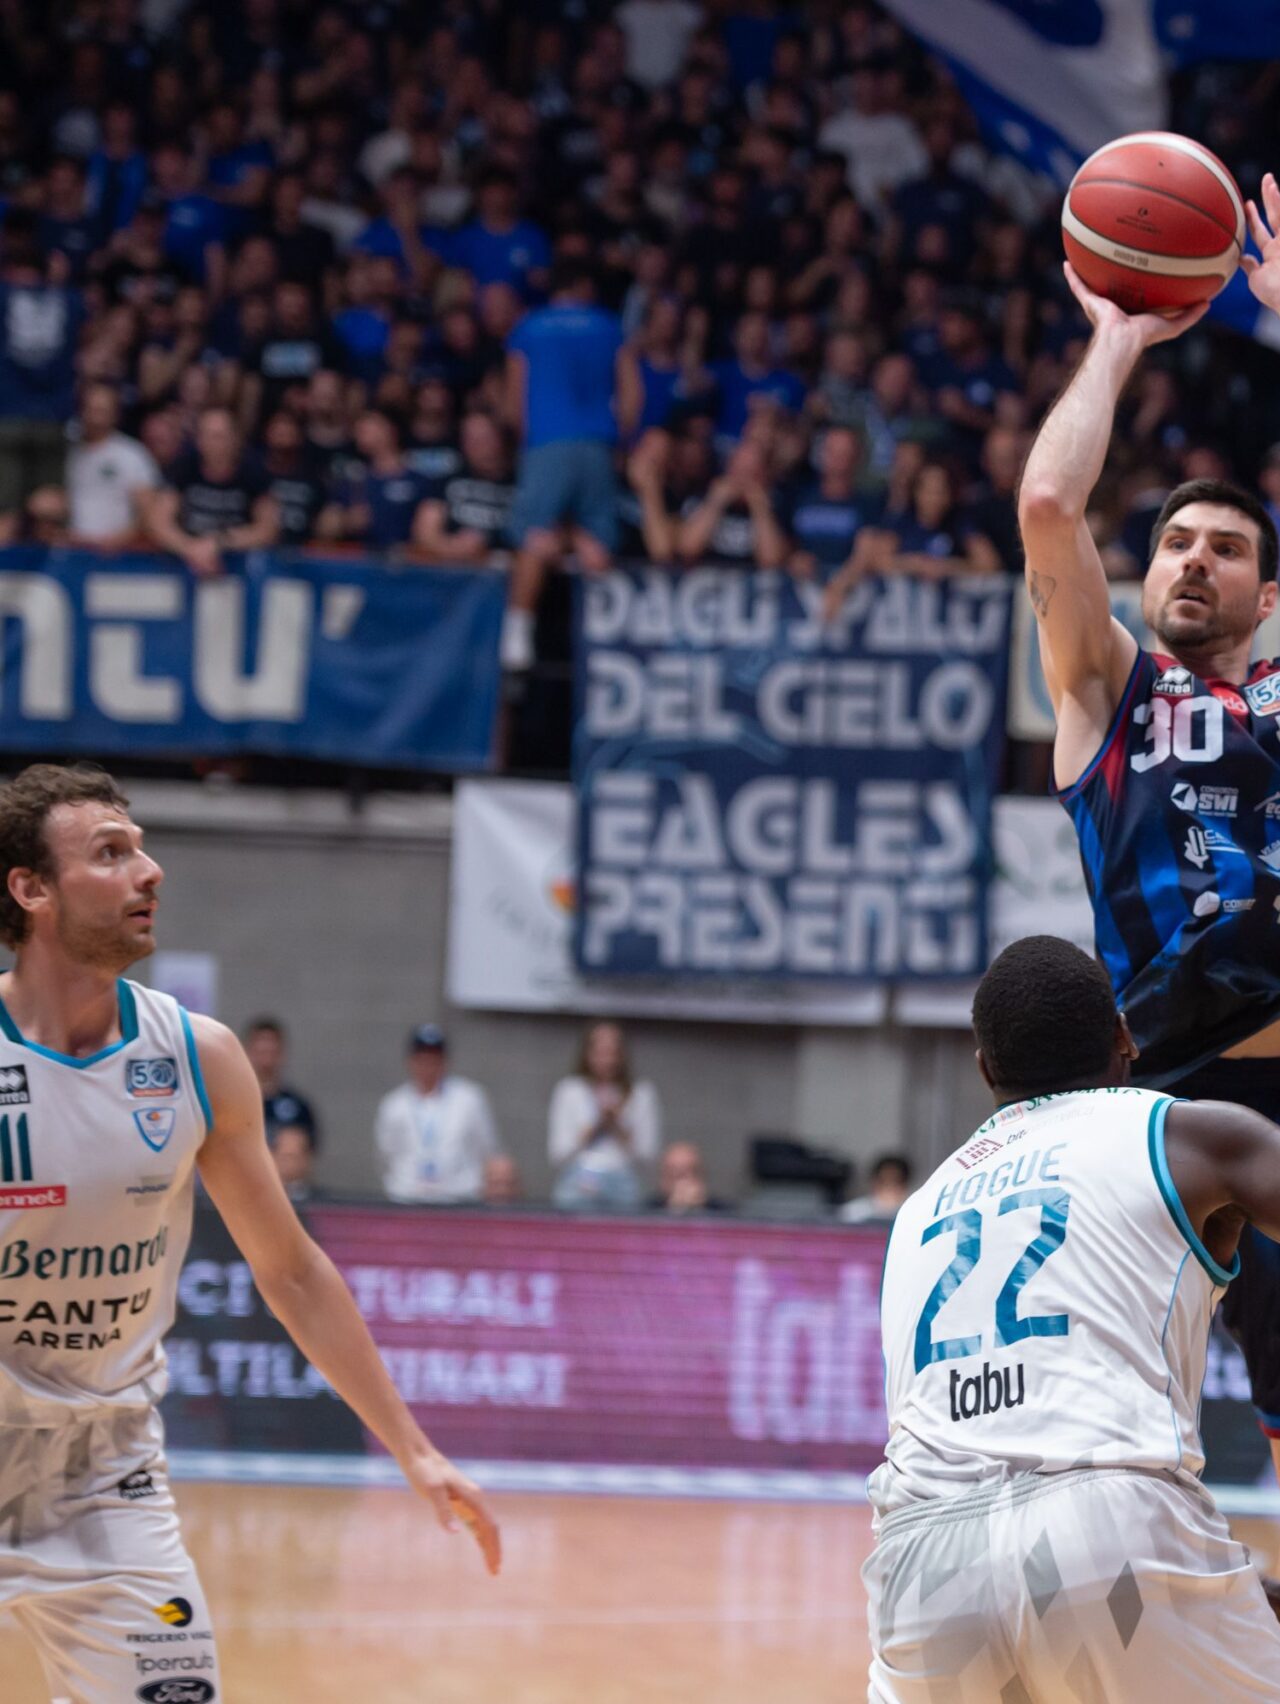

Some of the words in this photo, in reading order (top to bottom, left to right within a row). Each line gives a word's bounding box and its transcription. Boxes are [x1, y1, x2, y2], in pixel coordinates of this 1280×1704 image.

[585, 649, 740, 742] DEL
[756, 659, 995, 751] CIELO
[1130, 695, 1224, 774] 30
[588, 769, 979, 877] EAGLES
[1198, 793, 1239, 812] SWI
[581, 871, 981, 975] PRESENTI
[0, 1189, 62, 1208] nnet
[932, 1141, 1069, 1217] HOGUE
[914, 1186, 1071, 1376] 22
[13, 1326, 123, 1351] ARENA
[727, 1256, 892, 1446] tab
[948, 1362, 1025, 1423] tabu
